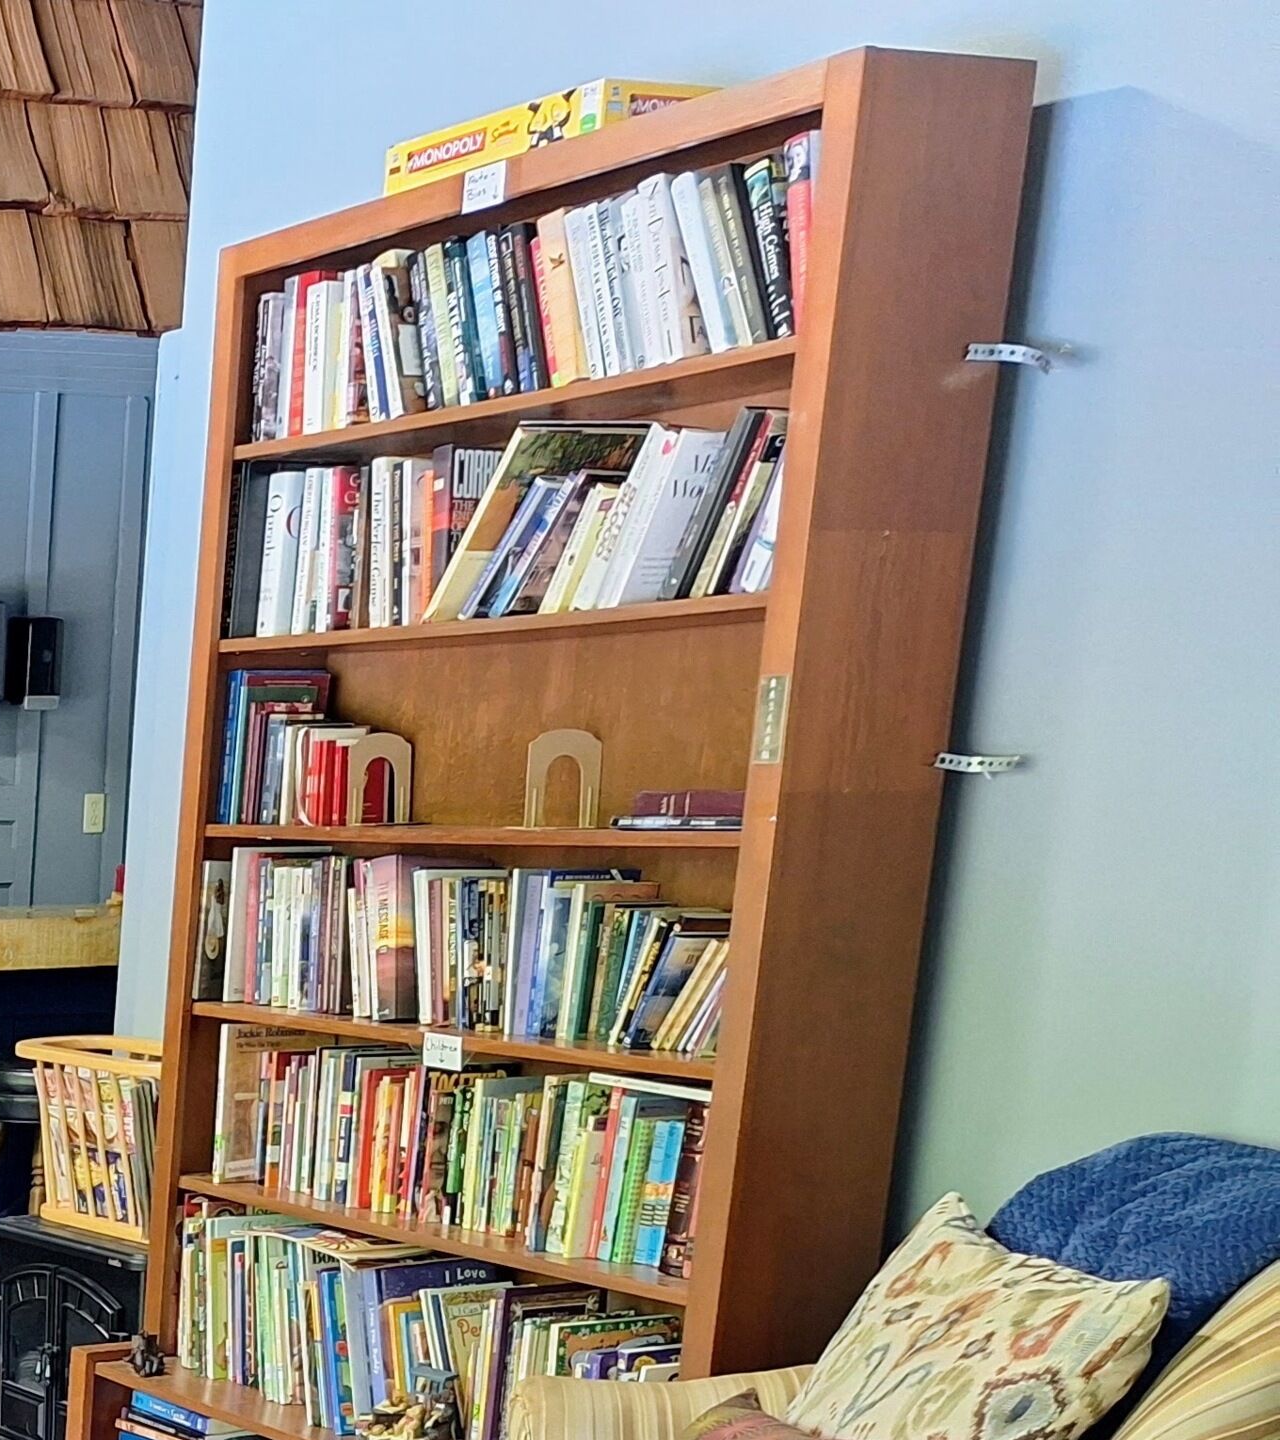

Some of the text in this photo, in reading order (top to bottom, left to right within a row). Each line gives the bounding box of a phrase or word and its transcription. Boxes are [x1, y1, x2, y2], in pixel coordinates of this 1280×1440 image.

[408, 131, 484, 169] MONOPOLY
[597, 207, 616, 263] Elizabeth
[611, 297, 622, 318] Off
[757, 202, 781, 280] High Crimes
[265, 494, 282, 557] Oprah
[370, 490, 382, 607] The Perfect Game
[378, 899, 390, 941] MESSAGE
[426, 1036, 458, 1053] Children
[457, 1267, 487, 1280] Love
